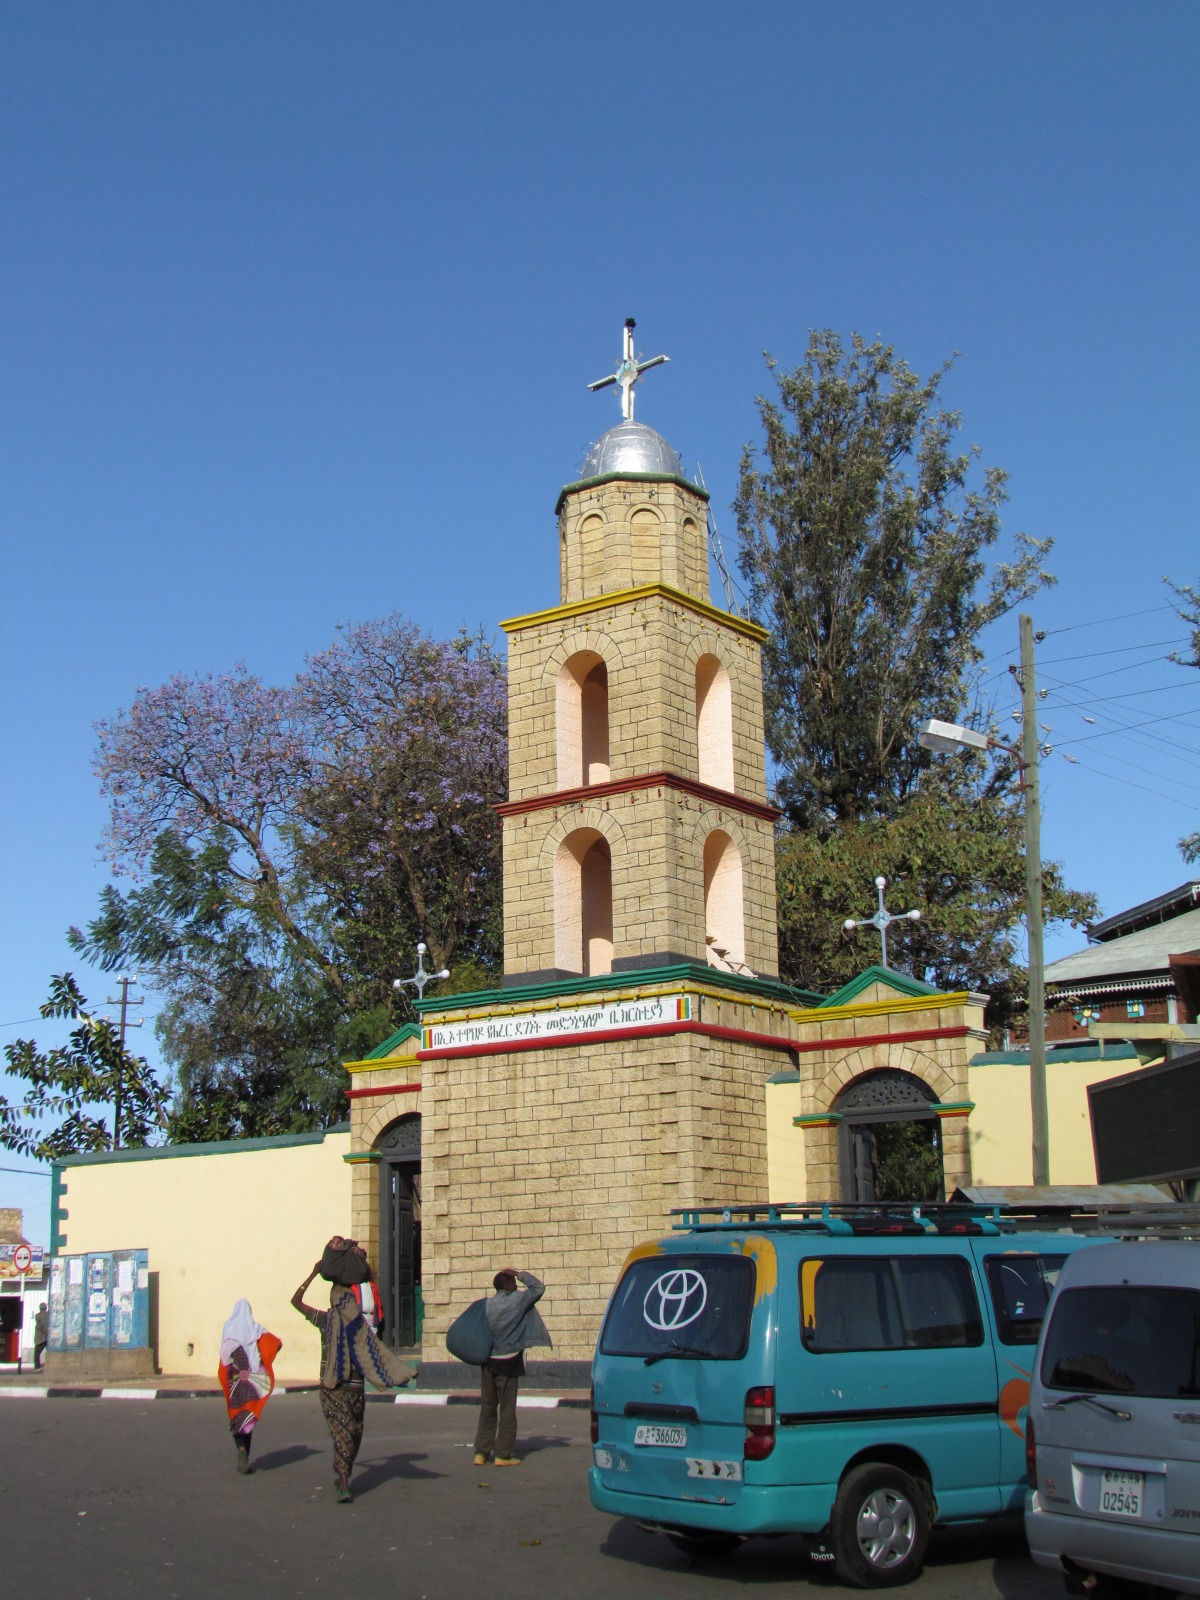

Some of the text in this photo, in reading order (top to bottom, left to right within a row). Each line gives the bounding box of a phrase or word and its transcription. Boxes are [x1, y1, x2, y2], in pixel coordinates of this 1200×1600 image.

[655, 1428, 681, 1444] 36603
[1103, 1491, 1139, 1515] 02545
[810, 1552, 835, 1561] TOYOTA
